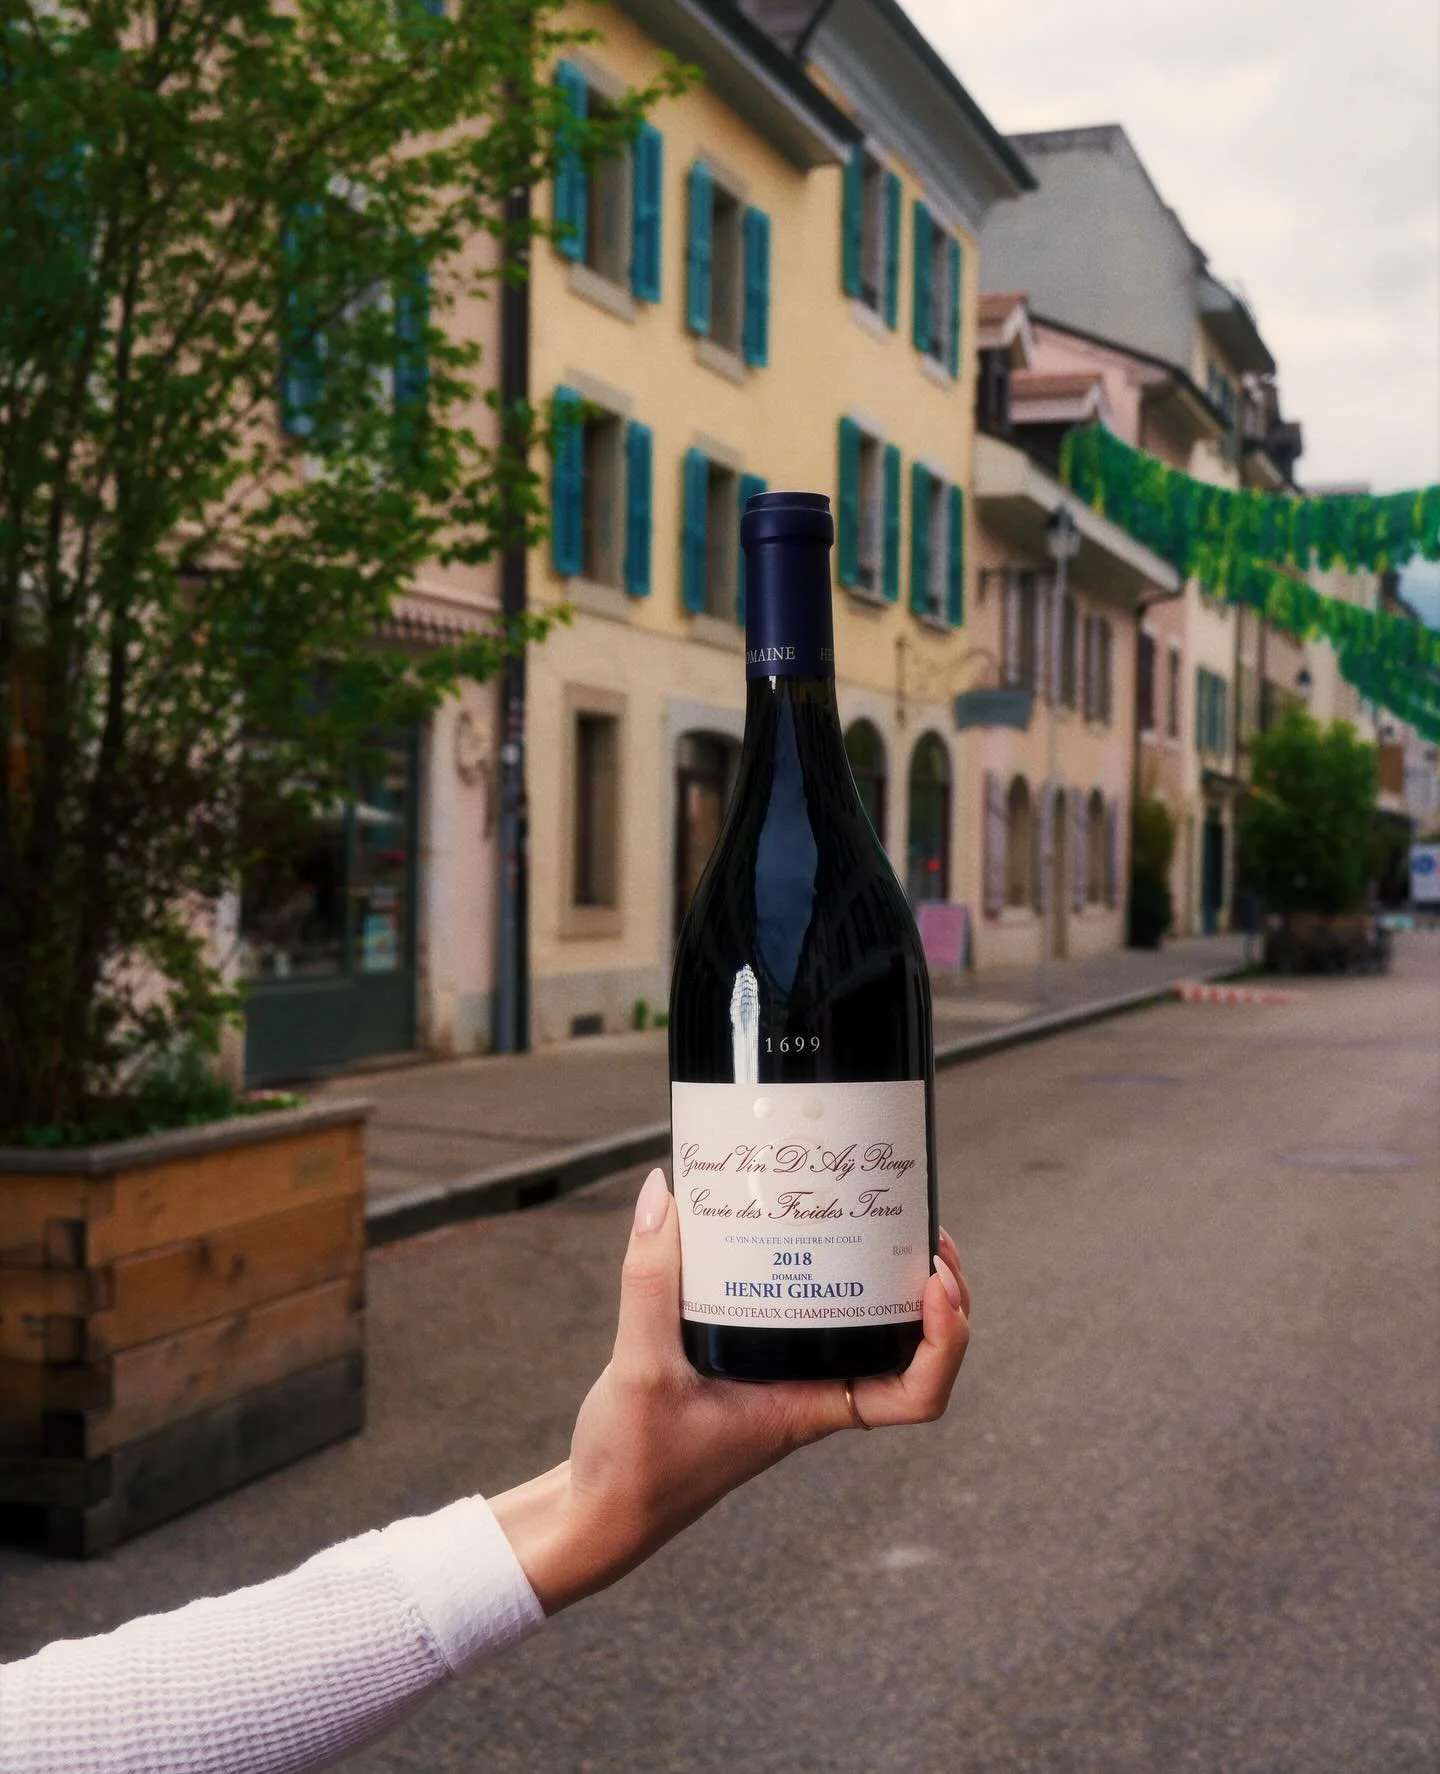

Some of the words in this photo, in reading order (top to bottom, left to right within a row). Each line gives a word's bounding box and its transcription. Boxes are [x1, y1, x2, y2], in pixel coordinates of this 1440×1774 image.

[765, 1036, 820, 1052] 1699
[680, 1142, 733, 1177] Grand
[735, 1144, 773, 1173] Vin
[861, 1142, 916, 1178] Rouge
[690, 1187, 733, 1217] Cuvée
[735, 1199, 762, 1218] des
[767, 1191, 844, 1220] Froides
[850, 1188, 904, 1217] Terres
[736, 1236, 749, 1244] VIN
[783, 1236, 793, 1244] NI
[795, 1236, 822, 1245] FILTRE
[824, 1236, 835, 1244] NI
[836, 1235, 863, 1244] COLLE
[773, 1252, 813, 1266] 2018
[772, 1273, 813, 1281] DOMAINE
[725, 1282, 782, 1298] HENRI
[788, 1282, 864, 1299] GIRAUD
[727, 1307, 781, 1319] COTEAUX
[785, 1306, 866, 1319] CHAMPENOIS
